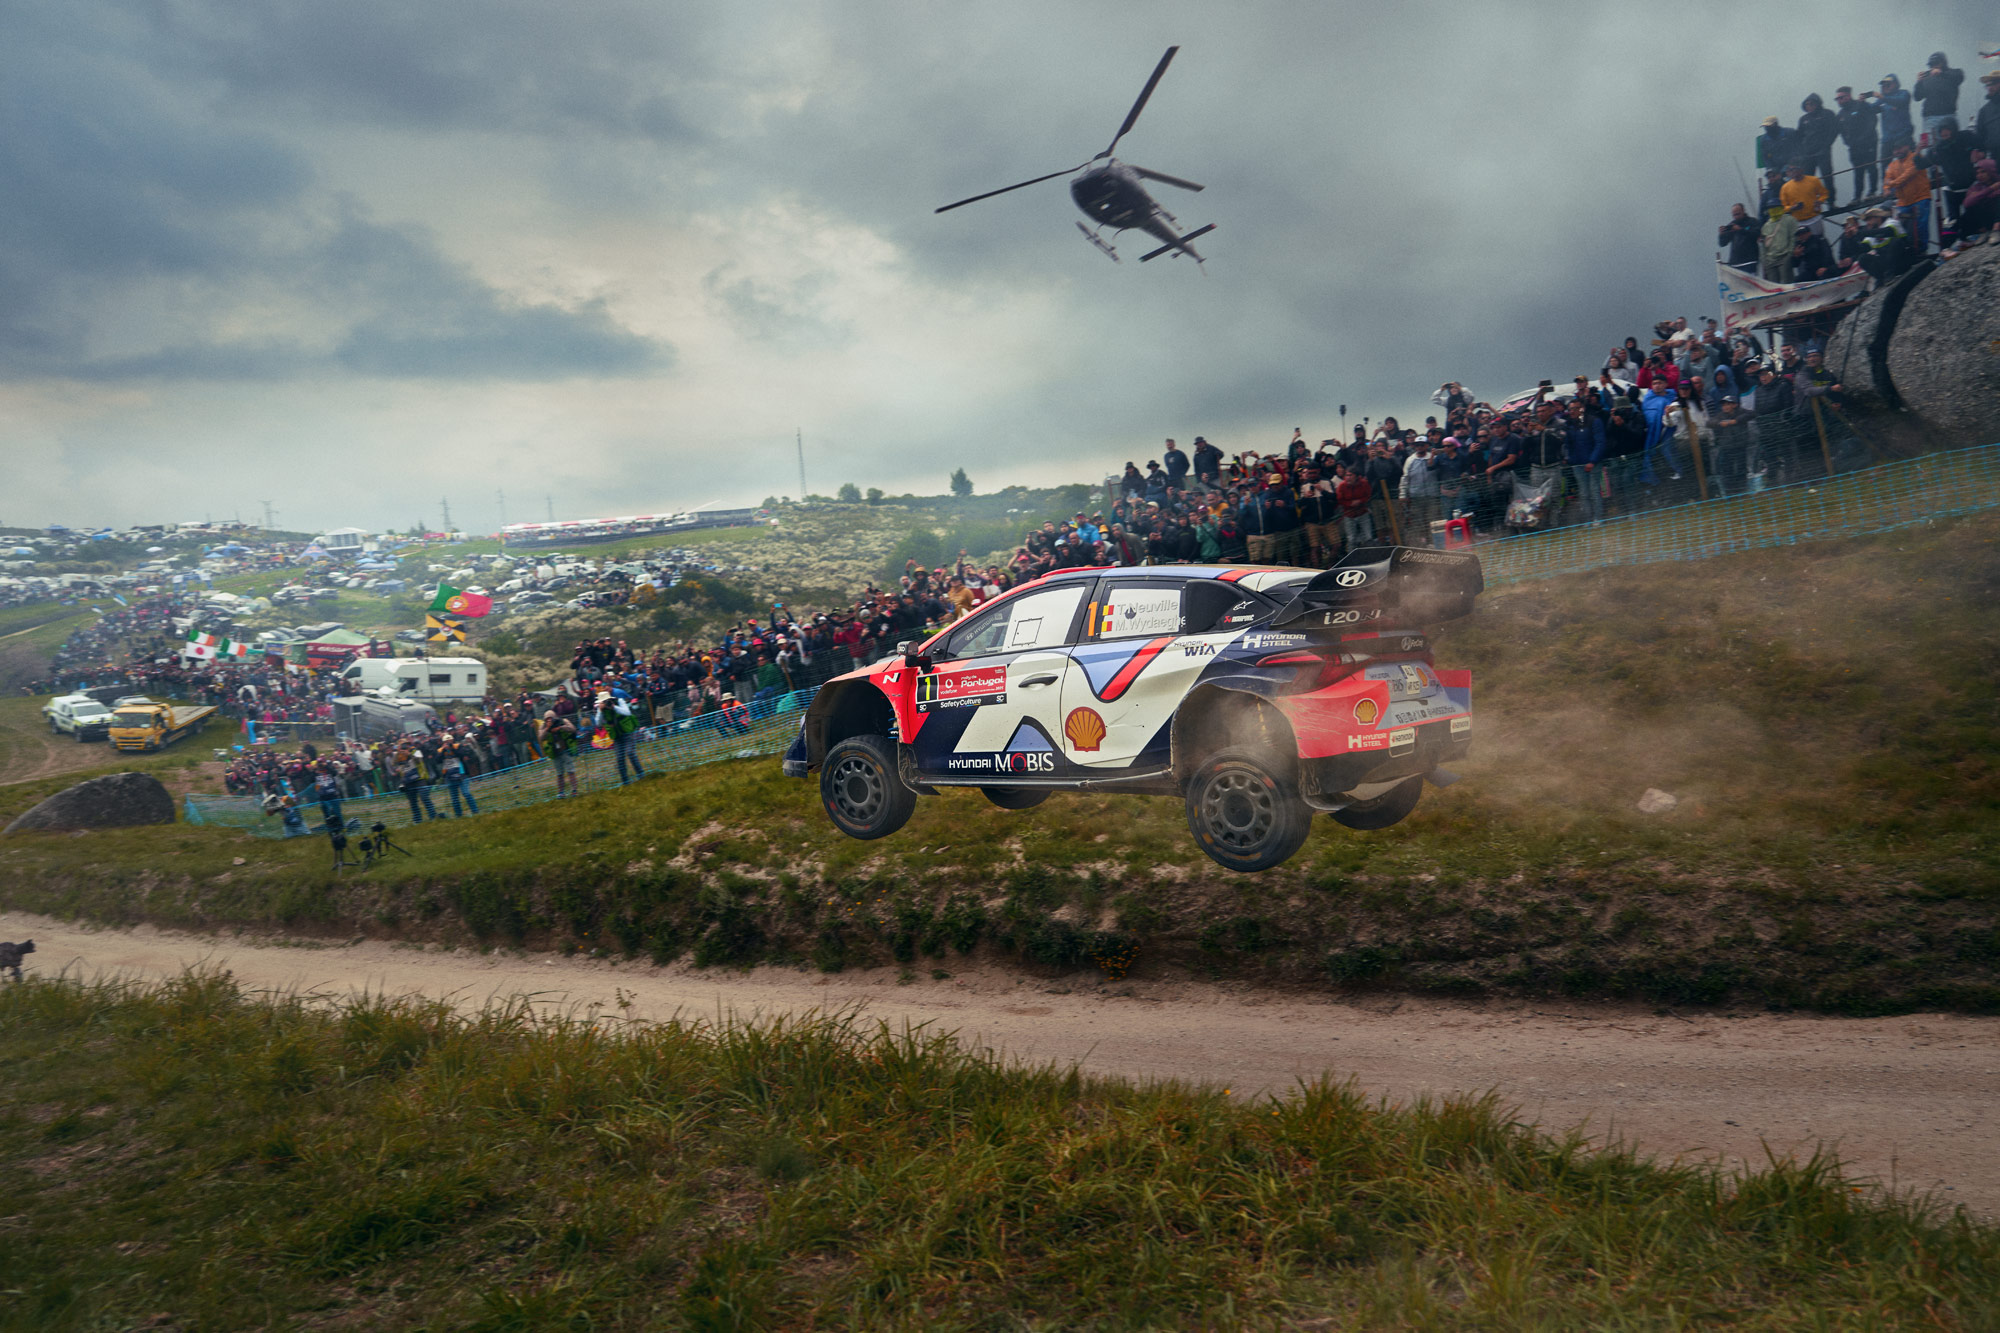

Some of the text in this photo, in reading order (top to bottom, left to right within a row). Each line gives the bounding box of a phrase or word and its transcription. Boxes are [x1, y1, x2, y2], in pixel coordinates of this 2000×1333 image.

[1128, 600, 1179, 615] Neuville
[1088, 601, 1098, 636] 1
[1324, 610, 1360, 625] i20
[1184, 643, 1216, 657] WIA
[924, 676, 931, 701] 1
[961, 676, 1005, 688] Portugal
[1362, 733, 1387, 741] HYUNDAI
[948, 752, 1055, 773] HYUNDAI MOBIS
